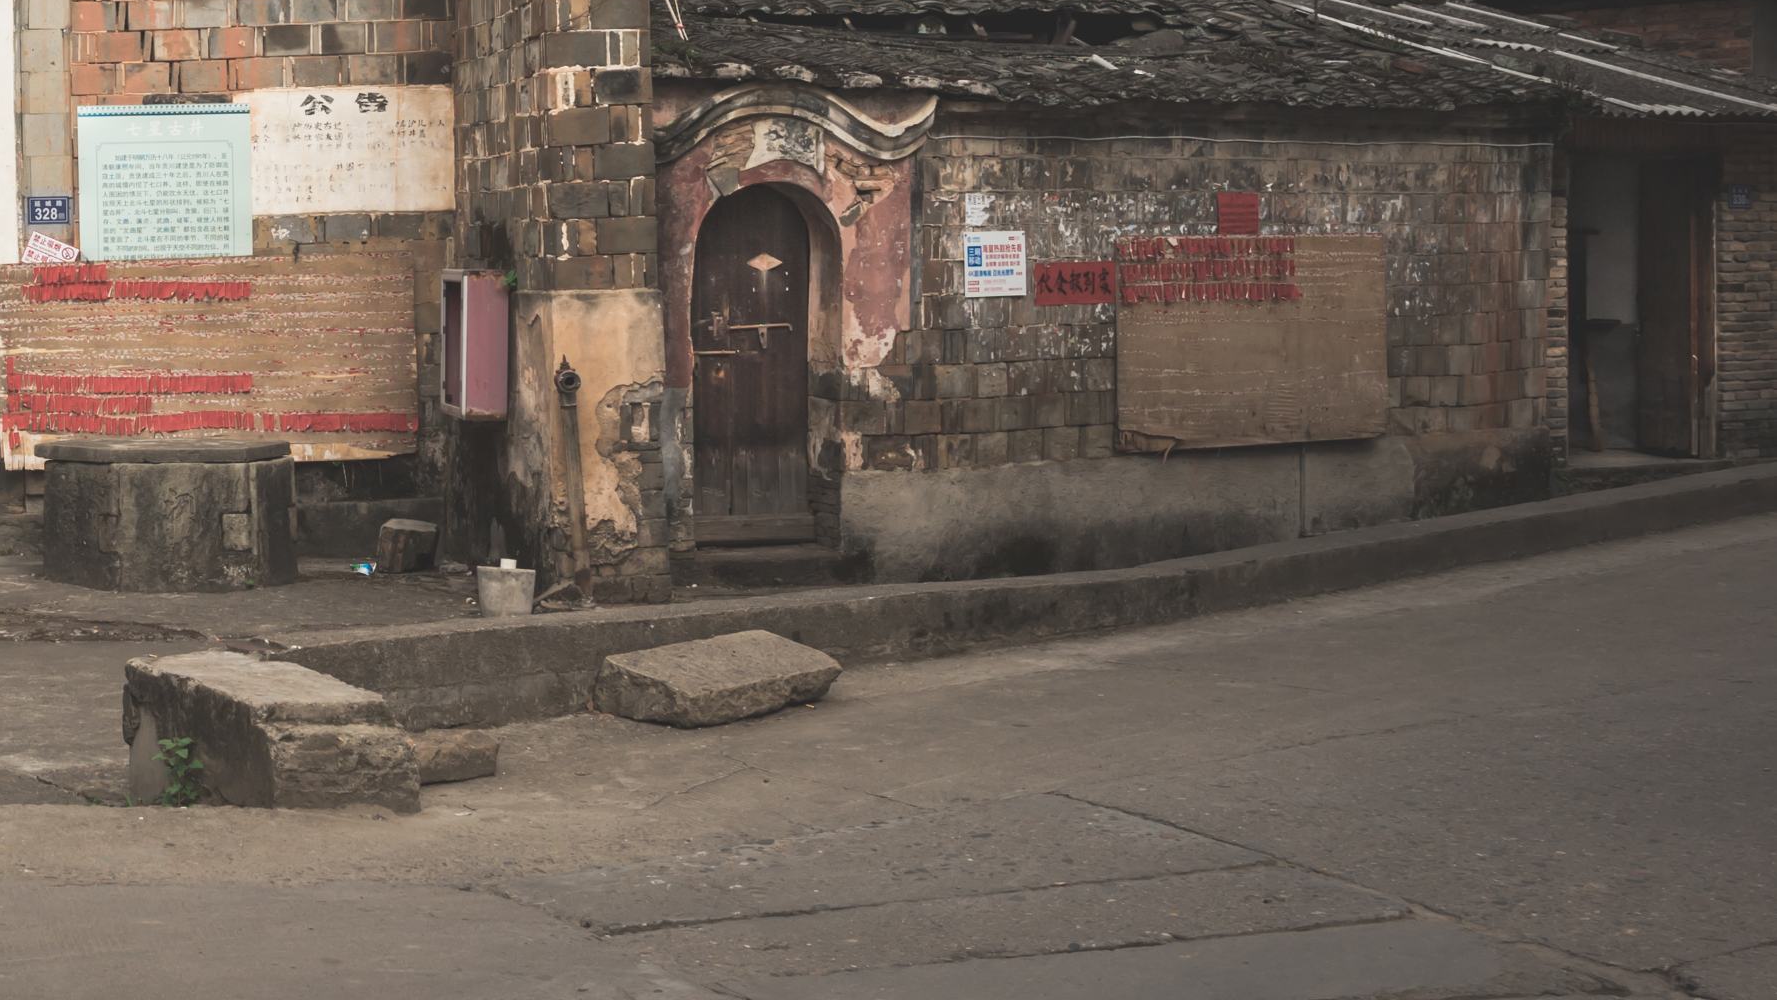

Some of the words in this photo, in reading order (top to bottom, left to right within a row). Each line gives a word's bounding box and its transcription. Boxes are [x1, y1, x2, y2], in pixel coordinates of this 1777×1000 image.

[300, 92, 388, 115] 公告
[126, 118, 204, 137] 七星古井
[34, 207, 58, 220] 328
